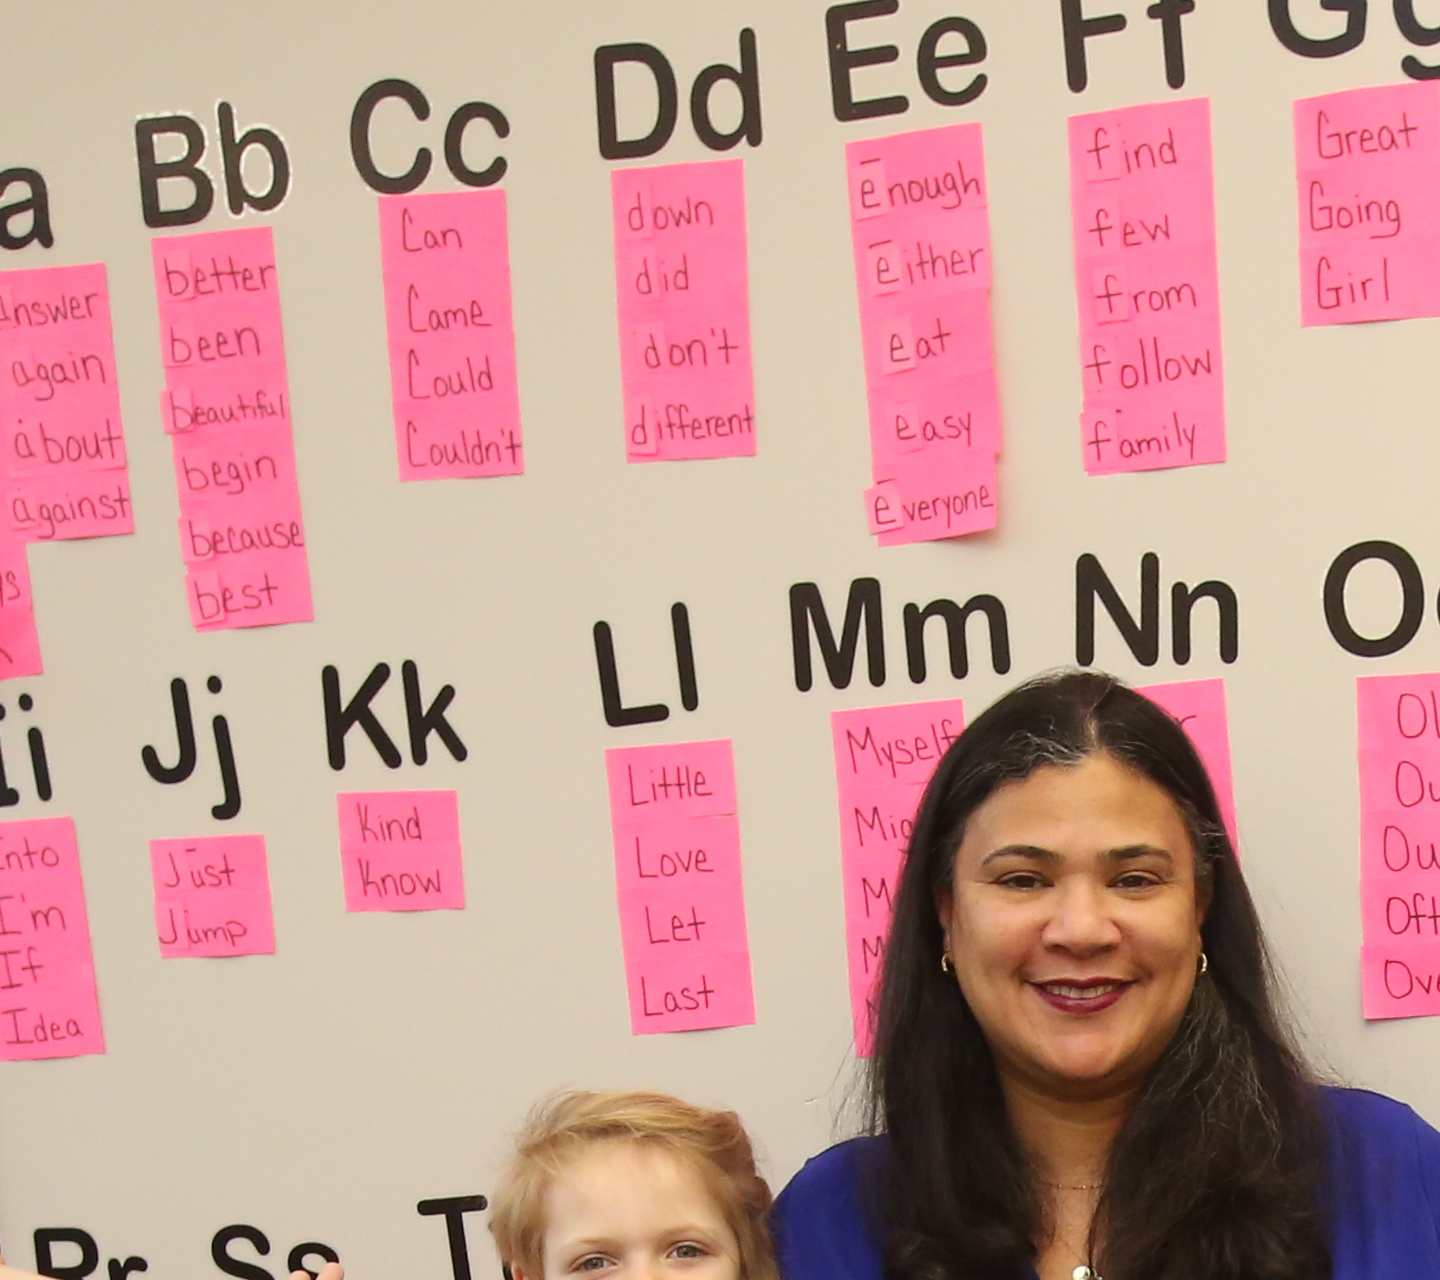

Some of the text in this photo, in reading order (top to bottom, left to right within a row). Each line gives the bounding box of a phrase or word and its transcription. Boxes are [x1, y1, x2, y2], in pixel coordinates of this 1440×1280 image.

[823, 2, 989, 122] Ee
[594, 28, 762, 159] Dd
[349, 78, 510, 193] Cc
[1317, 111, 1418, 159] Great
[135, 102, 290, 228] Bb
[1310, 181, 1401, 239] Going
[164, 259, 276, 296] better
[1317, 256, 1390, 309] Girl
[645, 327, 739, 368] don't
[889, 317, 951, 363] eat
[1086, 337, 1212, 388] follow
[12, 352, 106, 400] again
[170, 389, 285, 426] beautiful
[631, 404, 753, 445] different
[897, 410, 971, 447] easy
[13, 420, 123, 464] about
[406, 420, 521, 468] Couldn't
[1087, 412, 1195, 461] family
[12, 491, 131, 529] against
[188, 519, 305, 555] because
[1076, 552, 1239, 667] Nn
[789, 577, 1011, 692] Mm
[593, 602, 699, 727] Ll
[628, 765, 713, 807] Little
[357, 803, 422, 842] Kind
[165, 852, 235, 888] Just
[357, 858, 441, 897] Know
[636, 837, 714, 878] Love
[159, 910, 247, 948] Jump
[2, 1008, 83, 1044] Idea
